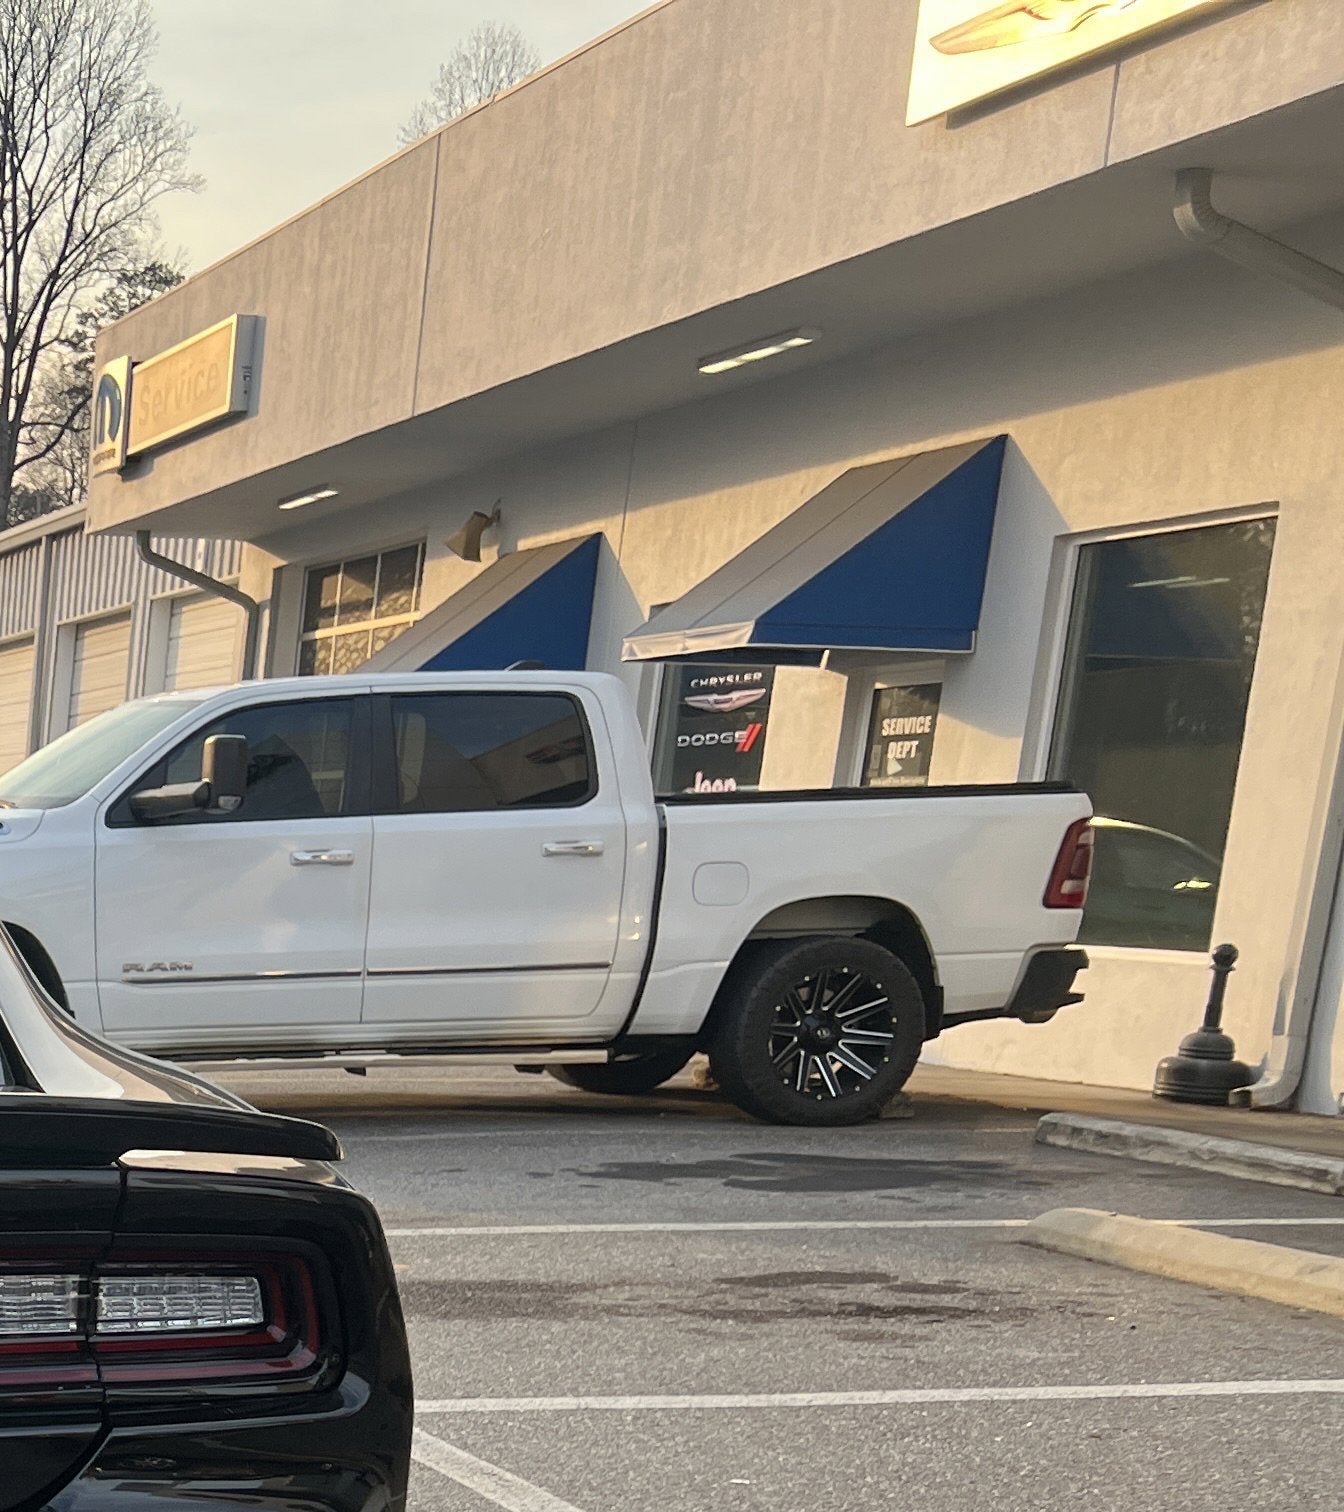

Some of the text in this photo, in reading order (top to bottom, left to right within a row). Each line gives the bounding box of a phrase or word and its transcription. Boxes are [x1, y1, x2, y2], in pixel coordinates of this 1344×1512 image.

[138, 362, 220, 426] Service
[690, 671, 762, 688] CHRYSLER
[882, 715, 931, 736] SERVICE
[677, 730, 747, 747] DODGE
[888, 741, 918, 759] DEPT
